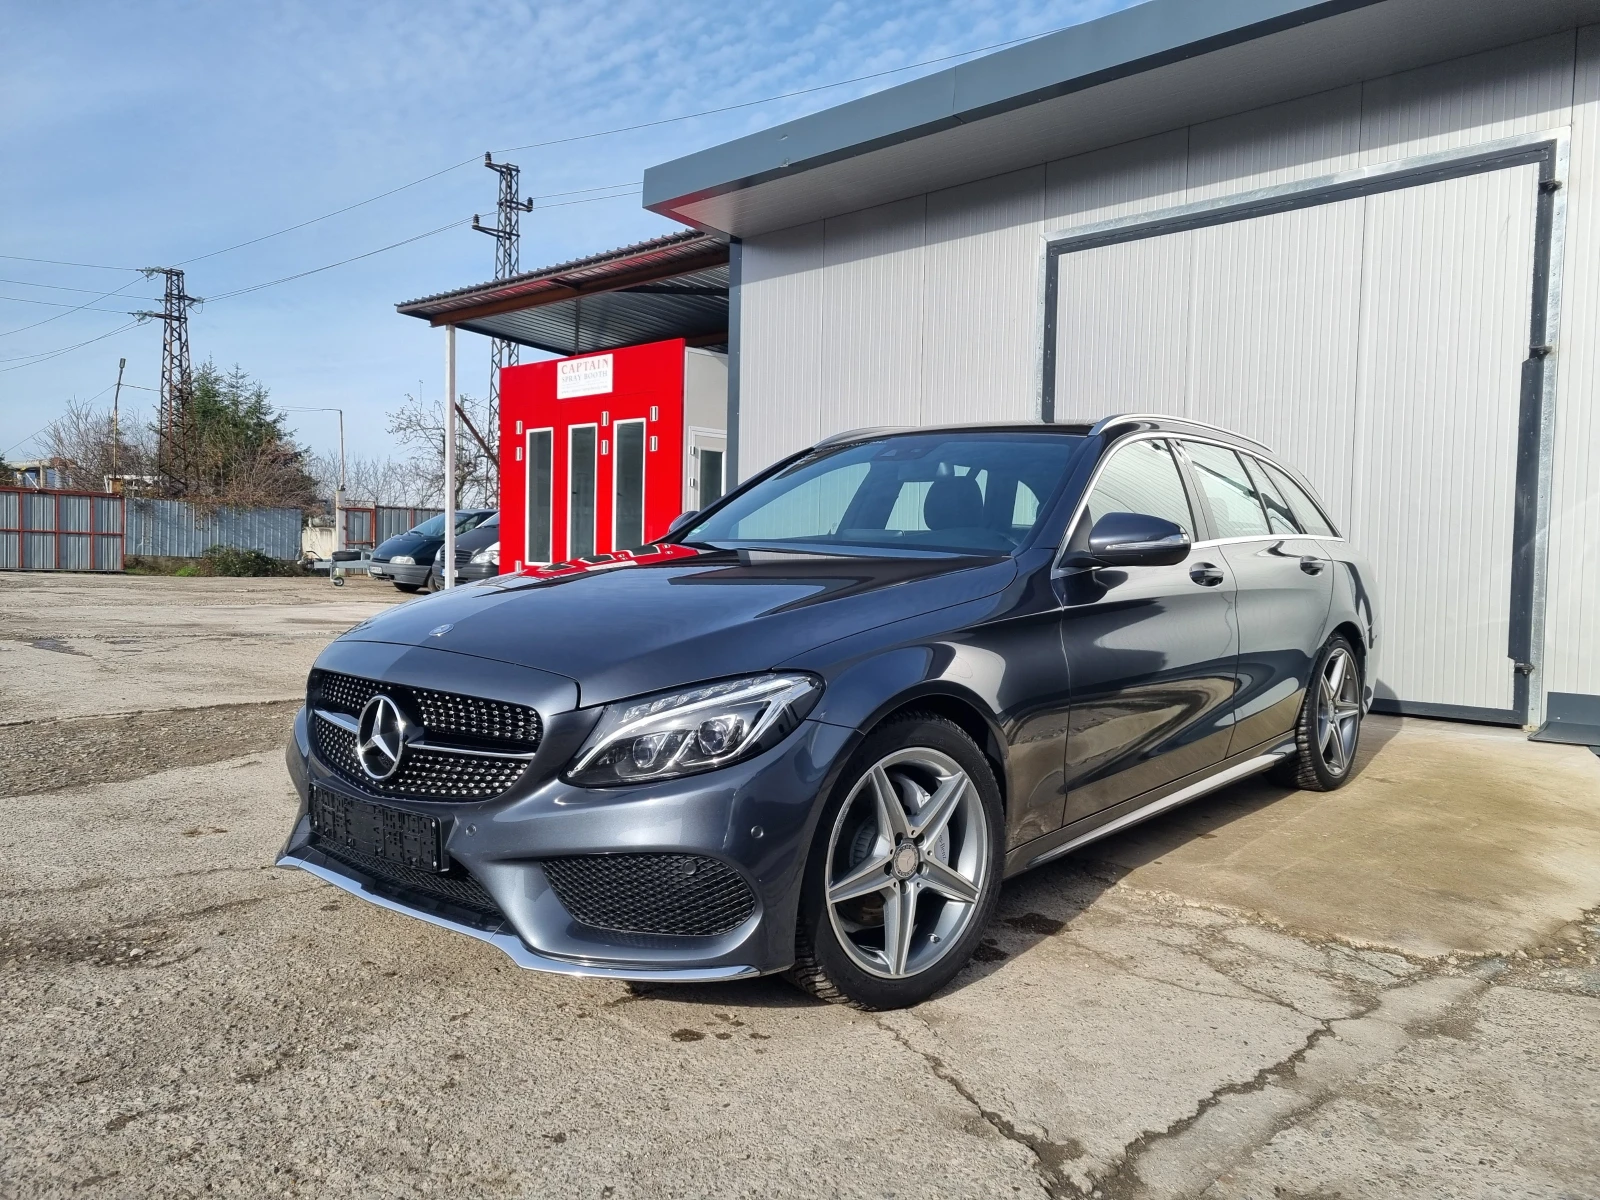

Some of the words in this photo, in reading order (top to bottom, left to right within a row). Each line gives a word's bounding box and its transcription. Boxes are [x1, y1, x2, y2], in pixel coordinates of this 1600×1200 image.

[561, 358, 608, 375] CAPTAIN
[562, 374, 581, 382] SPRAY
[584, 370, 608, 380] BOOTH
